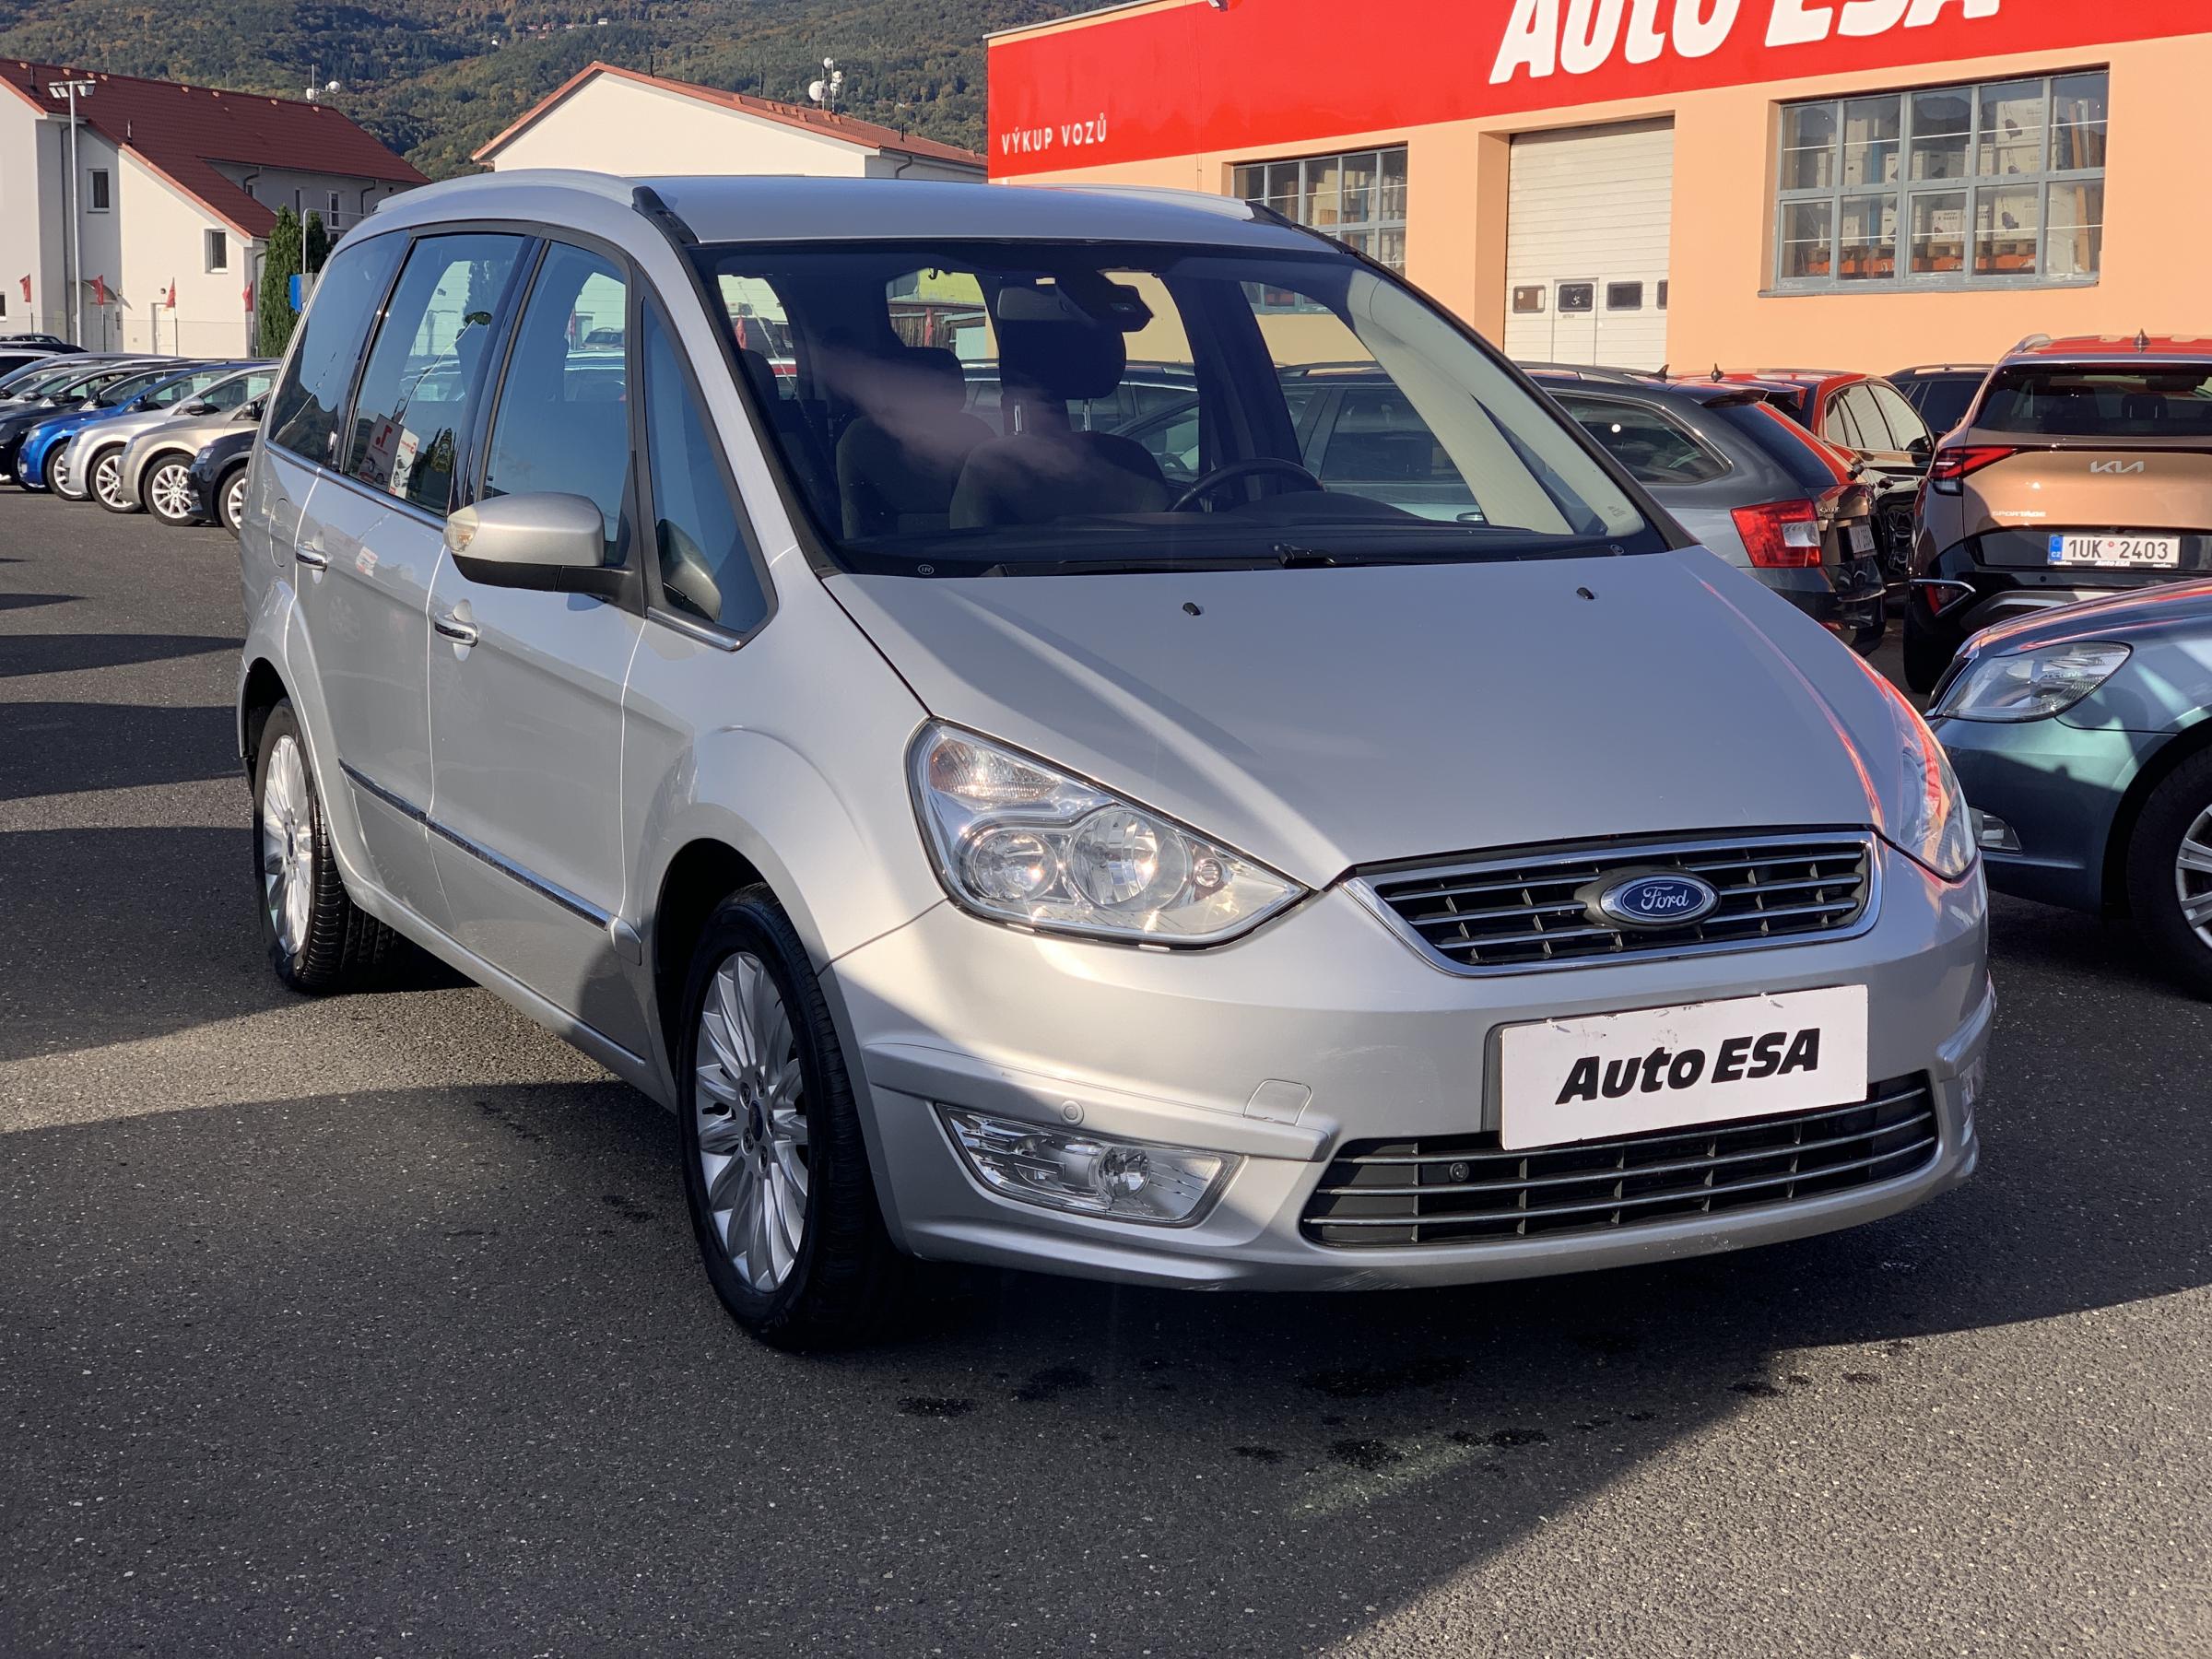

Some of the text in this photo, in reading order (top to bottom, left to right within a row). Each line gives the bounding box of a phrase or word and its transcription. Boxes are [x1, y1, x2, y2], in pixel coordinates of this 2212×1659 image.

[1001, 112, 1106, 156] VÝKUP VOZŮ
[2068, 539, 2169, 559] 1UK 2403
[1641, 886, 1689, 911] Ford
[1555, 1028, 1820, 1105] Auto ESA
